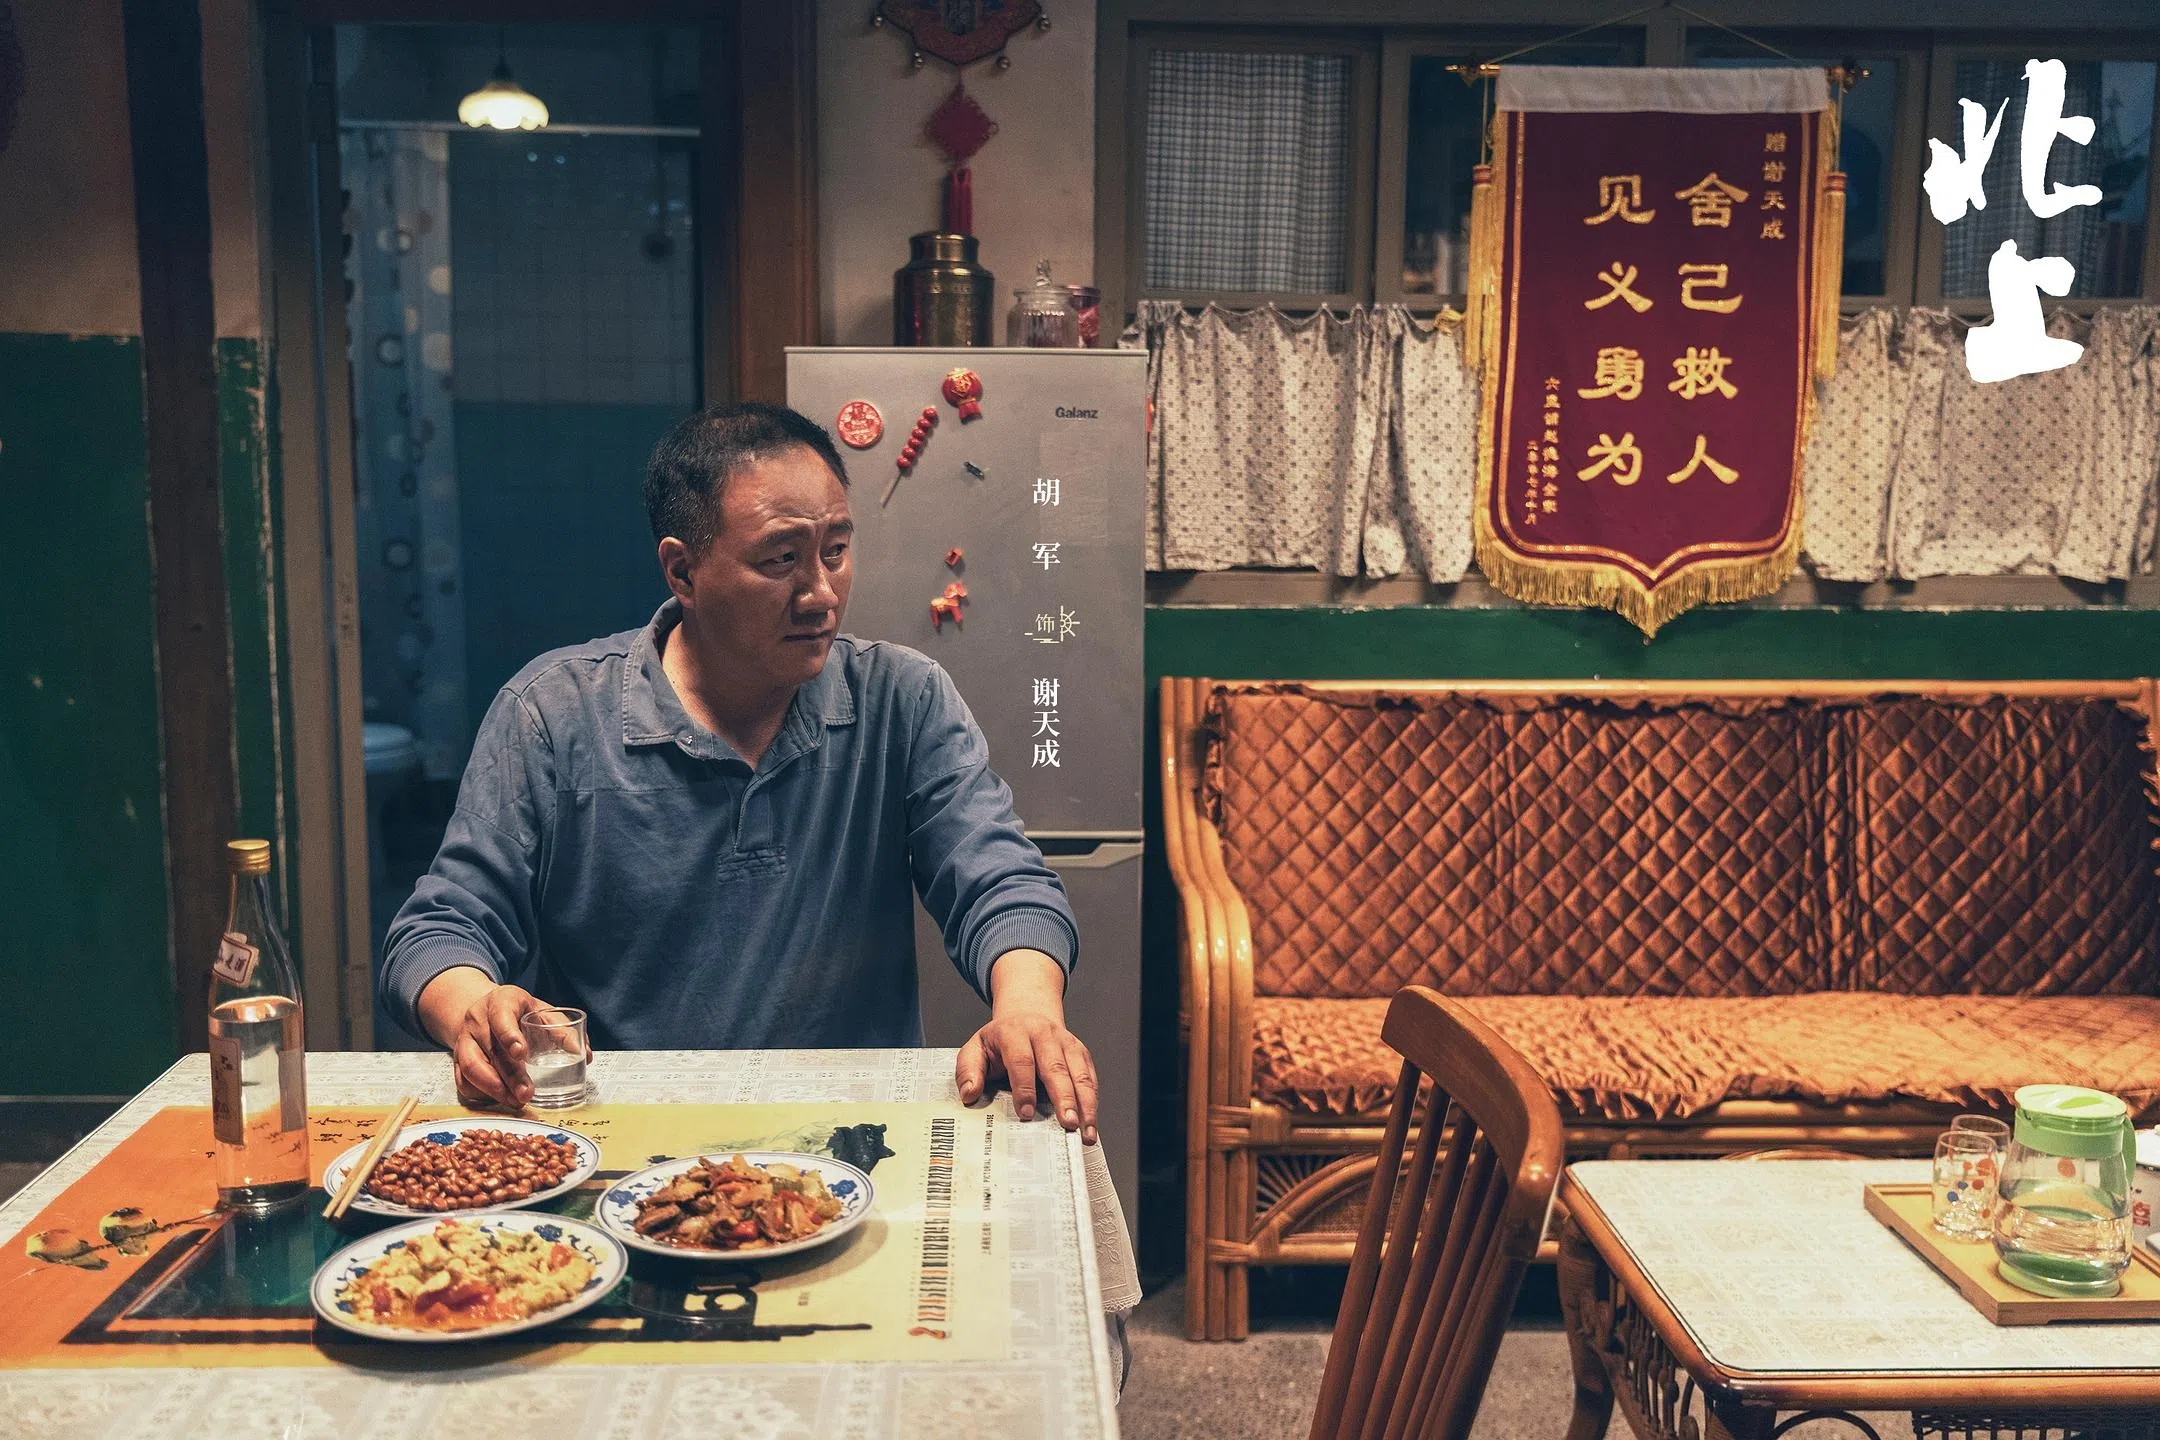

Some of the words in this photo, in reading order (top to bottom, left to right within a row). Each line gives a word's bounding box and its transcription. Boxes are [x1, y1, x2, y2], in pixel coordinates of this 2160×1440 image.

[1055, 406, 1099, 419] Galanz
[1576, 174, 1656, 487] 见义勇为
[1667, 172, 1750, 486] 舍己救人
